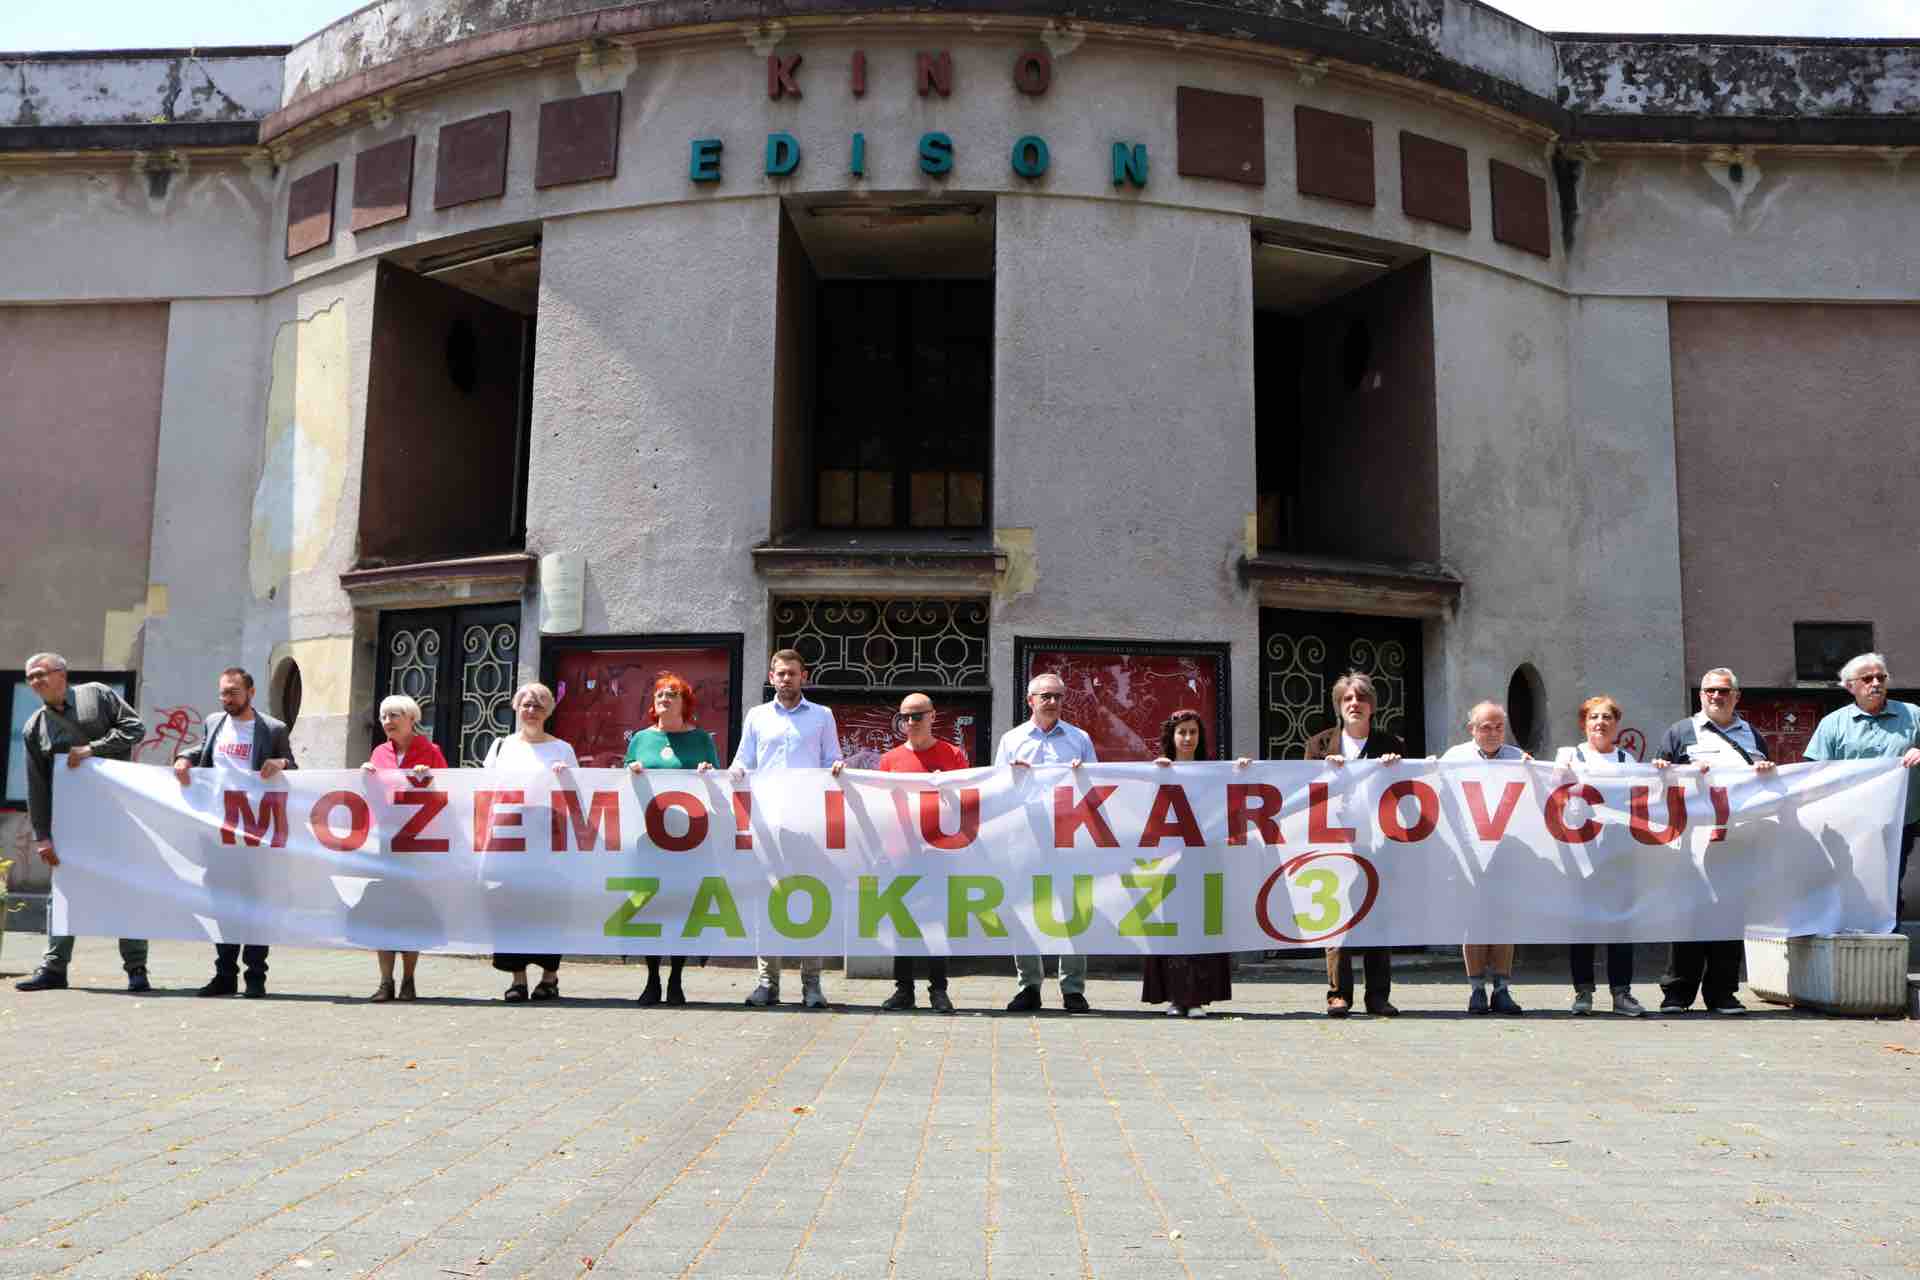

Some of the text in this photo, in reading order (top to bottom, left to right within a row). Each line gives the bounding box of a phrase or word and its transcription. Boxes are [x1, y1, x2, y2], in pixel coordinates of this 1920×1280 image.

[767, 49, 1052, 100] KINO
[690, 131, 1149, 189] EDISON
[220, 774, 1731, 853] MOŽEMO! I U KARLOVCU!
[603, 856, 1341, 939] ZAOKRUŽI 3
